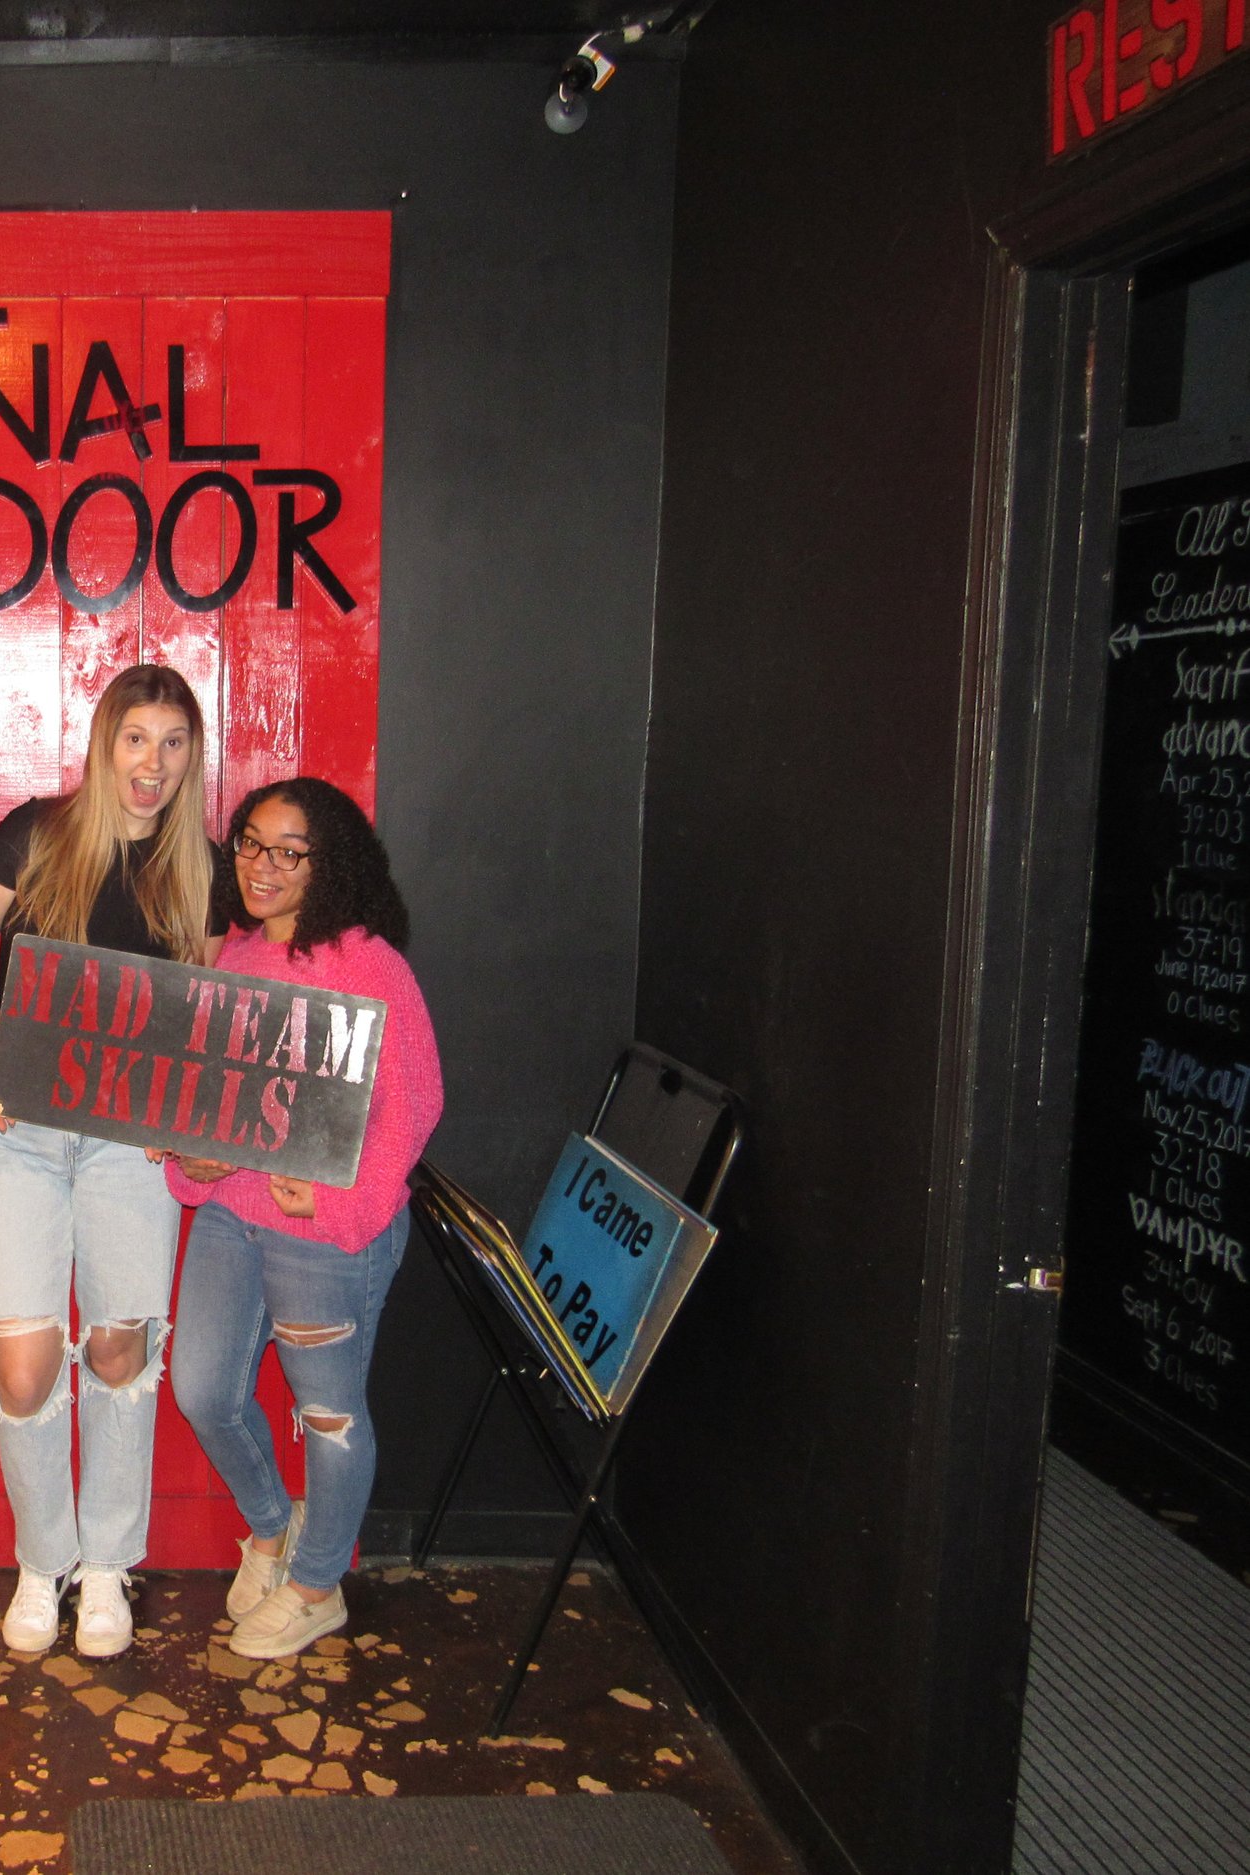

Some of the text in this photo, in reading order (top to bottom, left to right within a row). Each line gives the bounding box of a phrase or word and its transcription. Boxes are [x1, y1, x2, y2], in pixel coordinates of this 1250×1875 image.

[1175, 500, 1231, 557] All
[1154, 949, 1189, 980] June
[1176, 926, 1243, 969] 37:19
[5, 946, 378, 1085] MAD TEAM
[51, 1036, 298, 1153] SKILLS
[1151, 1130, 1222, 1190] 32:18
[578, 1167, 655, 1258] Came
[531, 1243, 618, 1370] To Pay
